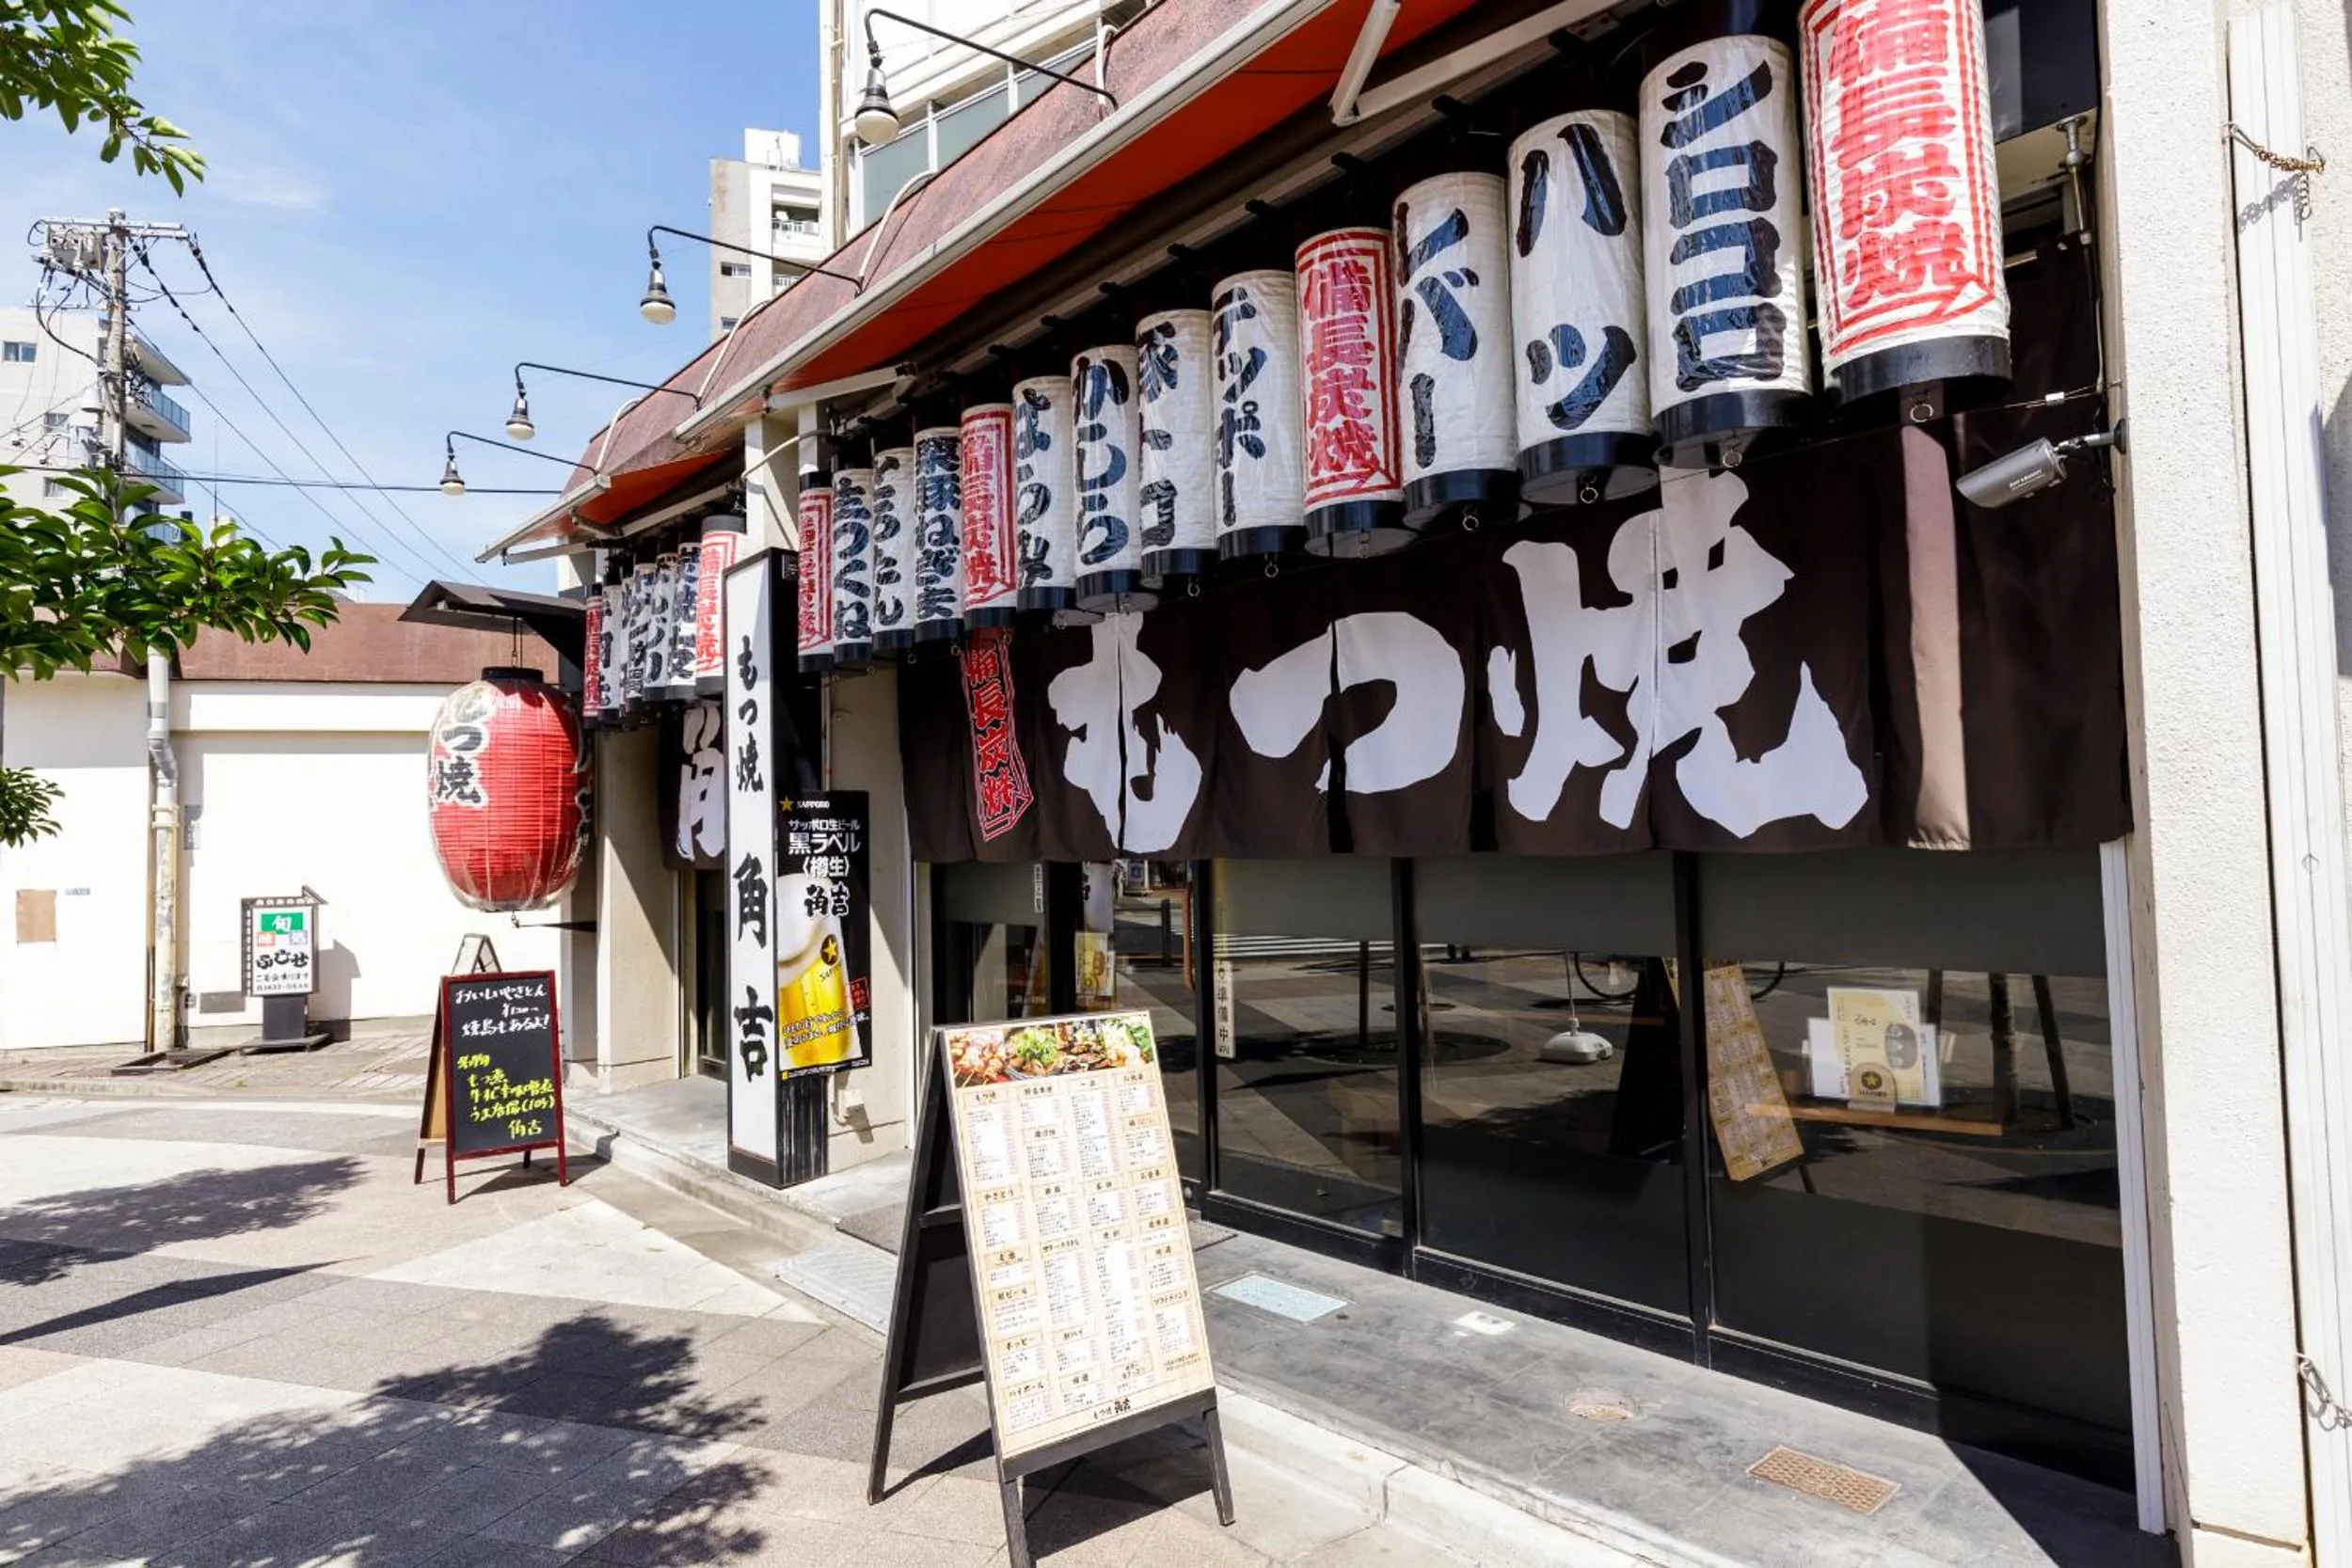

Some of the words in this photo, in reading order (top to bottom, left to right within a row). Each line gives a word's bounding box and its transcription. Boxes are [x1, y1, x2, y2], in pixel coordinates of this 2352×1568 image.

[1303, 260, 1378, 473] 備長炭焼
[1396, 200, 1480, 470] レバー
[1516, 123, 1638, 431] ハツ
[736, 634, 765, 793] もつ焼
[1046, 467, 1869, 853] もつ焼
[787, 818, 861, 832] サッポロ生ビール
[788, 832, 861, 855] 黒ラベル
[732, 851, 774, 1084] 角吉
